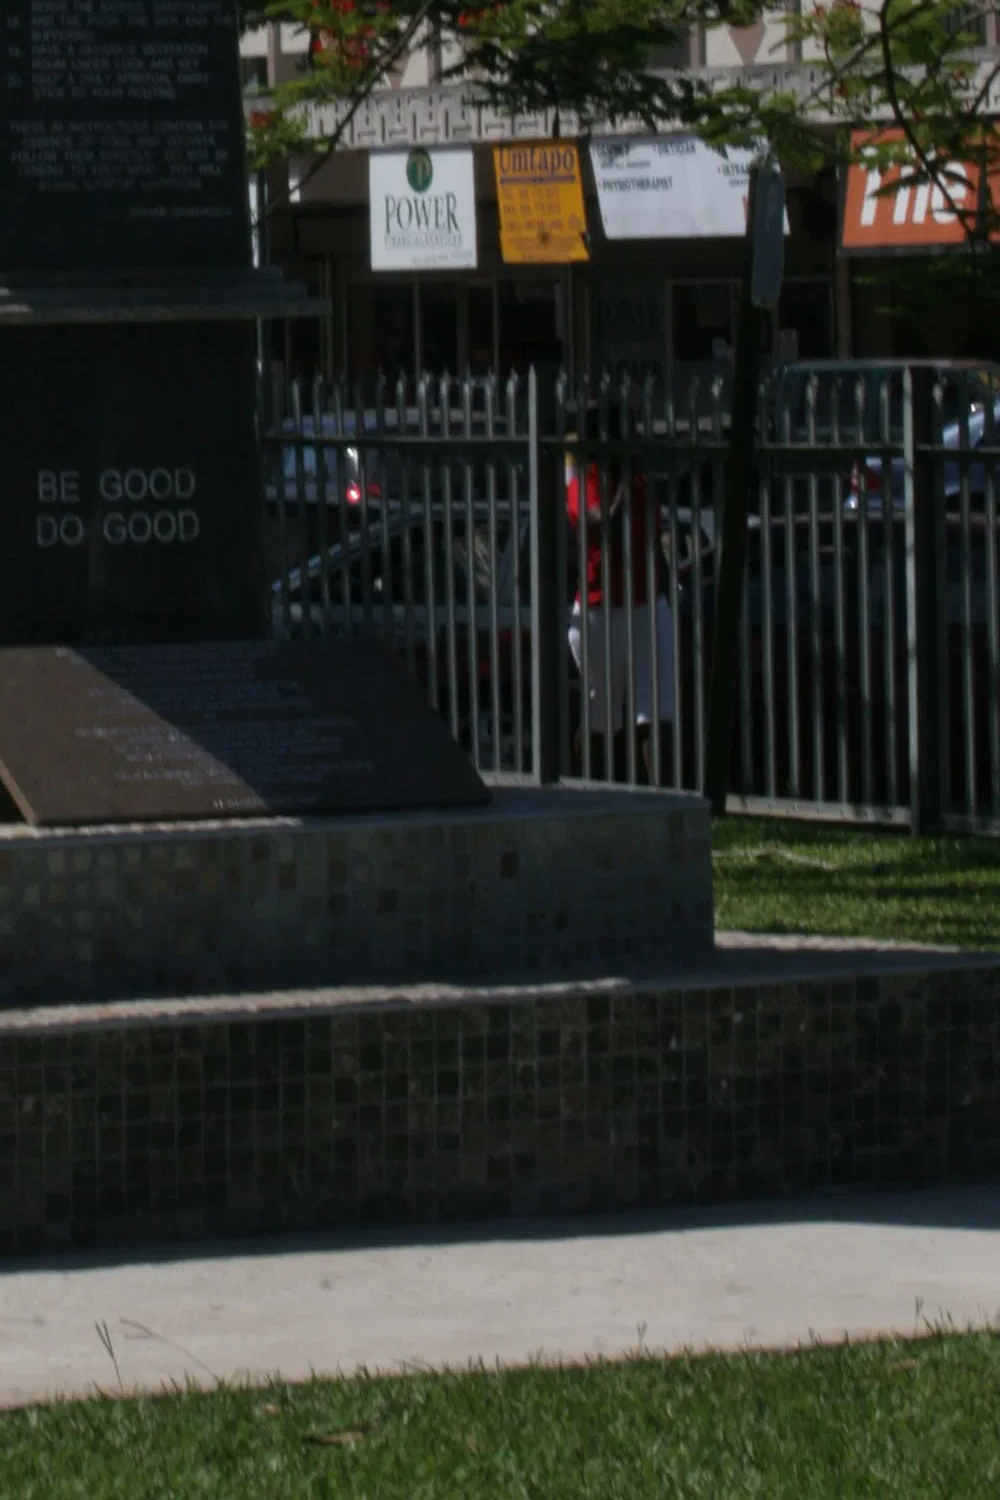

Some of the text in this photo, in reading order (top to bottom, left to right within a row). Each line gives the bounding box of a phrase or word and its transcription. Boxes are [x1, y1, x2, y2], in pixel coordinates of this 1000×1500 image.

[498, 146, 576, 176] Umtapo
[384, 192, 460, 234] POWER
[38, 466, 197, 503] BE GOOD
[36, 508, 200, 548] DO GOOD
